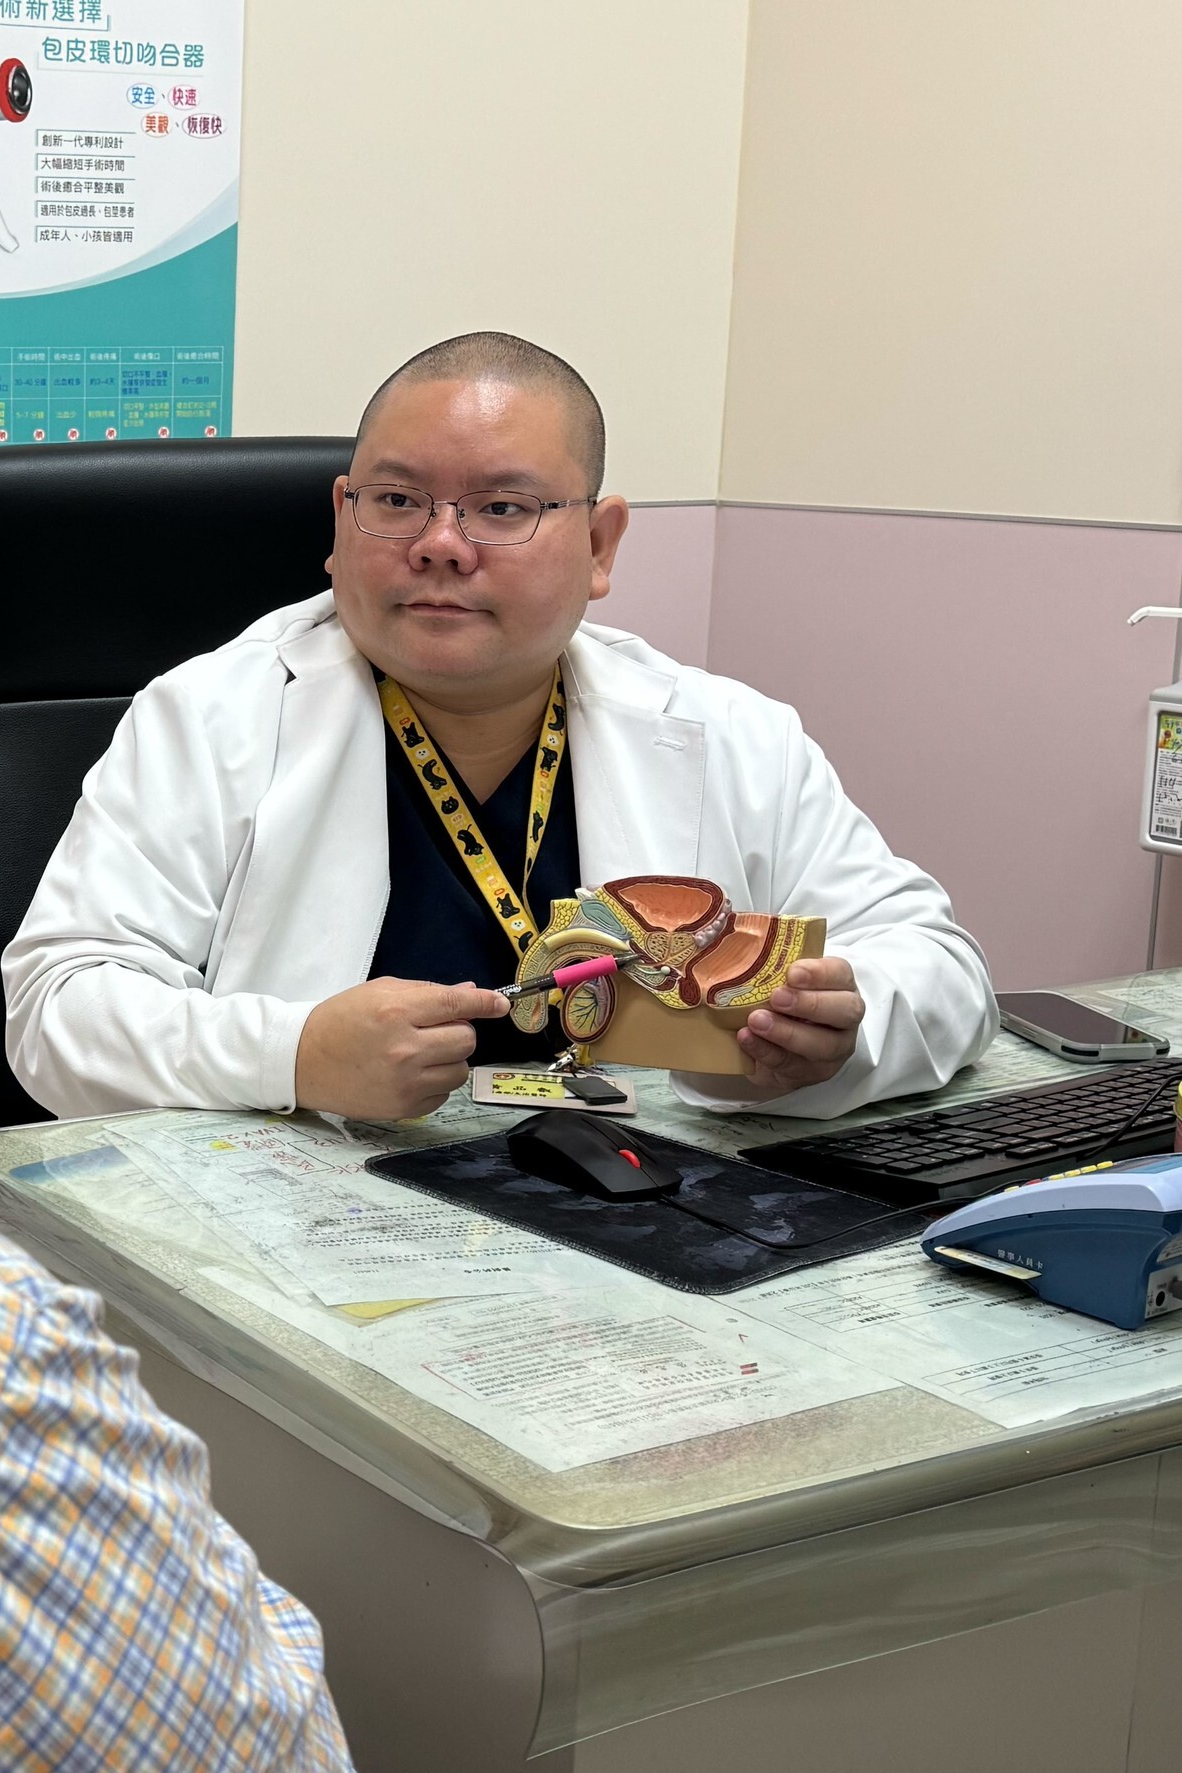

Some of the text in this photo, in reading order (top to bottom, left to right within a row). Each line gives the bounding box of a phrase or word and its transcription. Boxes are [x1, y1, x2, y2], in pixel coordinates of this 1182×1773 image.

[41, 36, 205, 68] 包皮環切吻合器
[42, 134, 124, 149] 創新一代專利設計
[41, 157, 125, 172] 大幅縮短手術時間
[41, 180, 124, 194] 術後癒合平整美觀
[40, 229, 133, 243] 成年人、小孩皆適用
